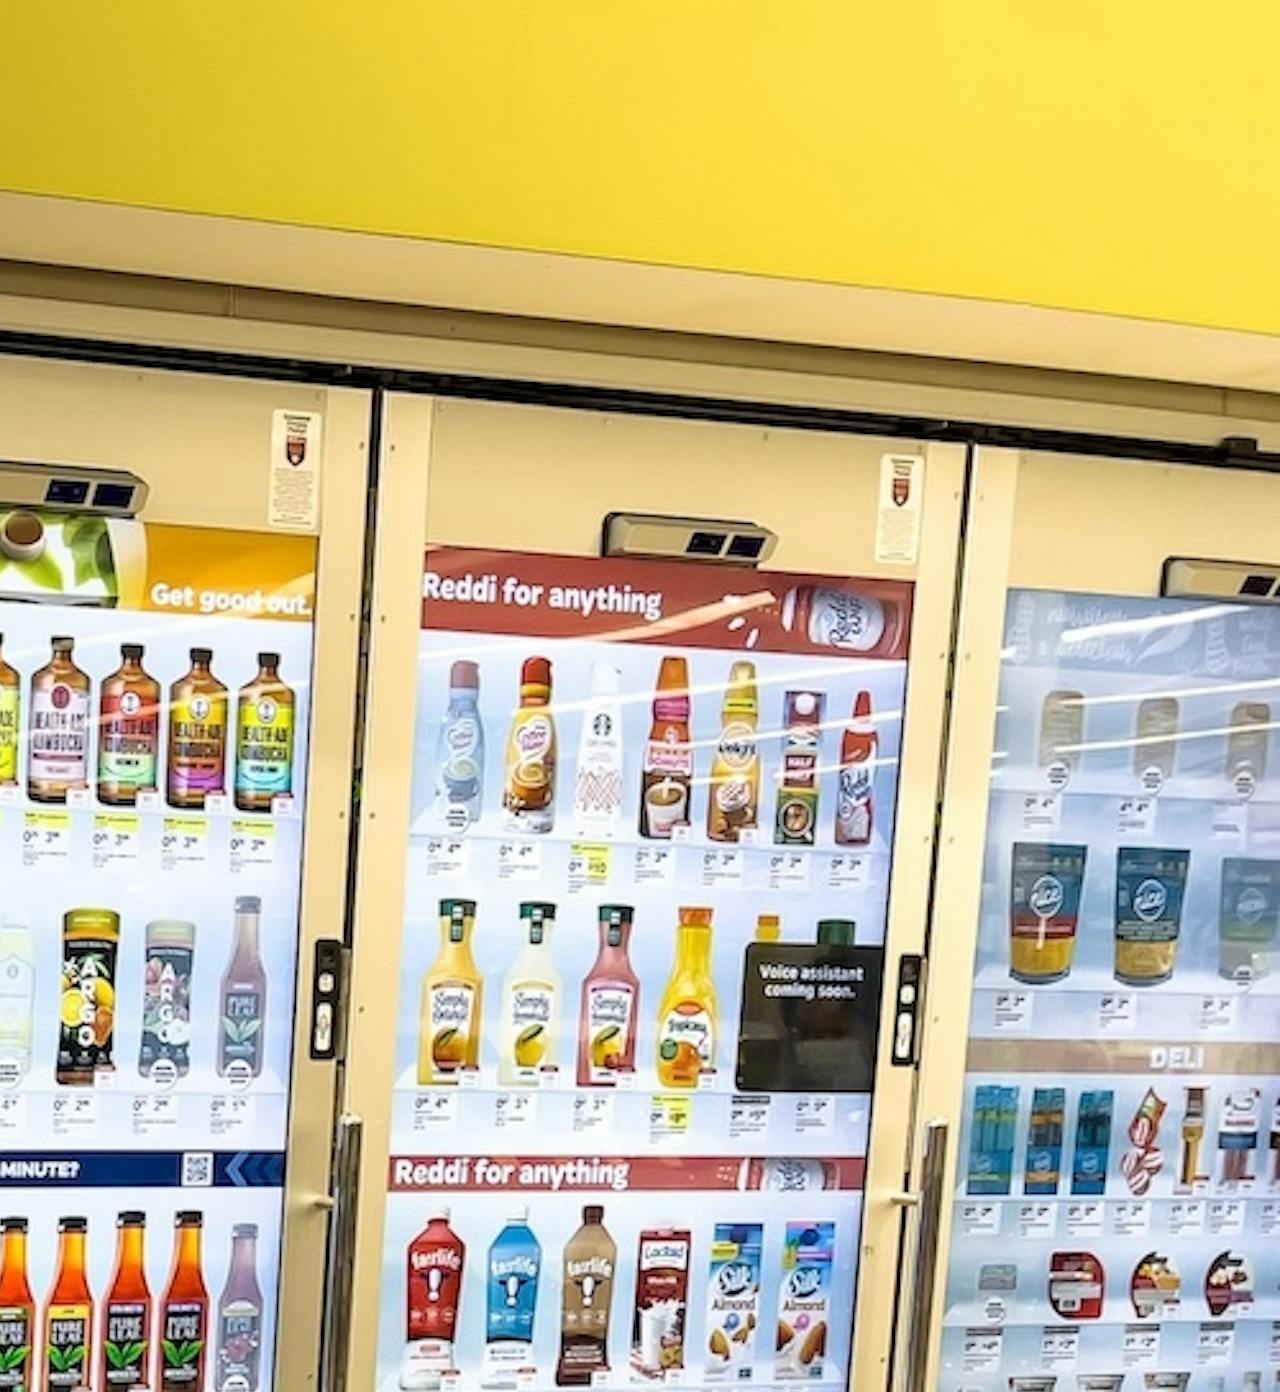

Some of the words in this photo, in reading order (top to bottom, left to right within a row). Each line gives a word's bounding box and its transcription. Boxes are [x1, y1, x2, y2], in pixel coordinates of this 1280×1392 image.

[151, 584, 193, 606] Get
[199, 588, 263, 613] good
[267, 594, 313, 615] out.
[423, 573, 496, 603] Reddi
[503, 577, 543, 605] for
[549, 583, 662, 622] anything
[759, 963, 798, 980] Voice
[801, 964, 864, 982] assistant
[764, 983, 816, 999] coming
[817, 985, 855, 998] soon.
[1150, 1048, 1204, 1069] DELI
[0, 1161, 80, 1178] MINUTE?
[395, 1160, 468, 1185] Reddi
[474, 1158, 512, 1185] for
[518, 1160, 630, 1188] anything
[711, 1297, 756, 1312] Almond
[783, 1298, 826, 1312] Almond
